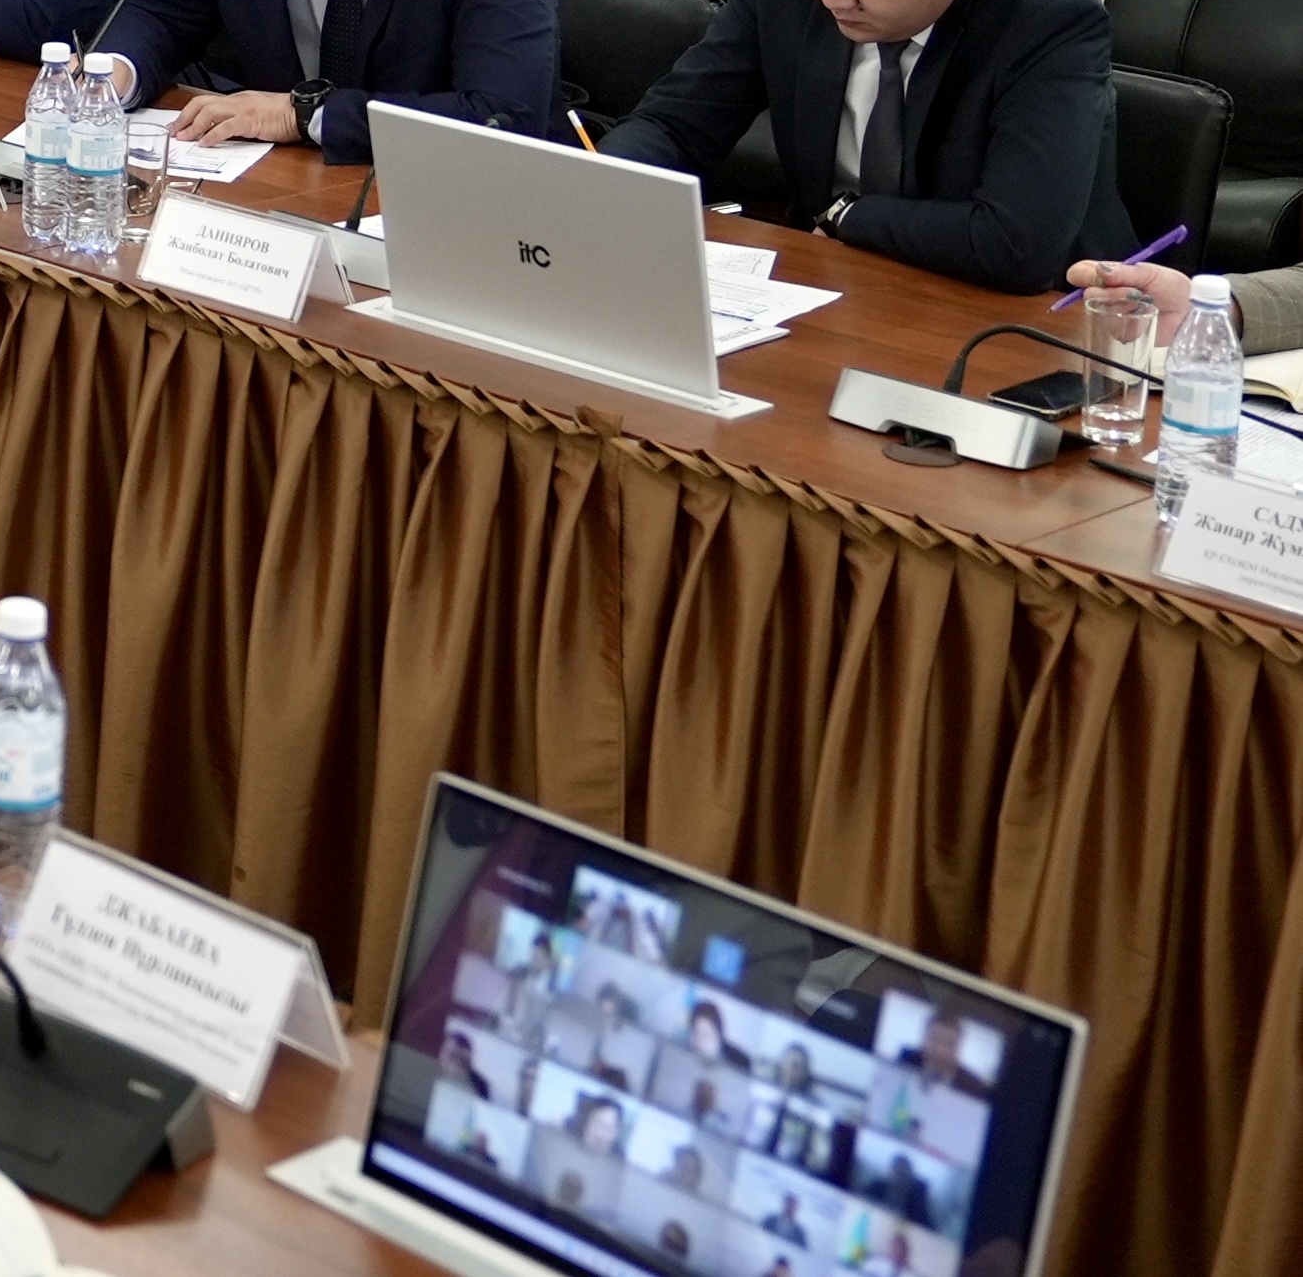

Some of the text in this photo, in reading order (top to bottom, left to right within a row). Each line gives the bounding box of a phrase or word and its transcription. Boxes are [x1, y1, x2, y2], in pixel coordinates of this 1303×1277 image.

[195, 224, 271, 254] ДАНИЯРОВ
[167, 235, 290, 279] Жанболат Болатович
[1194, 512, 1255, 546] Жанар
